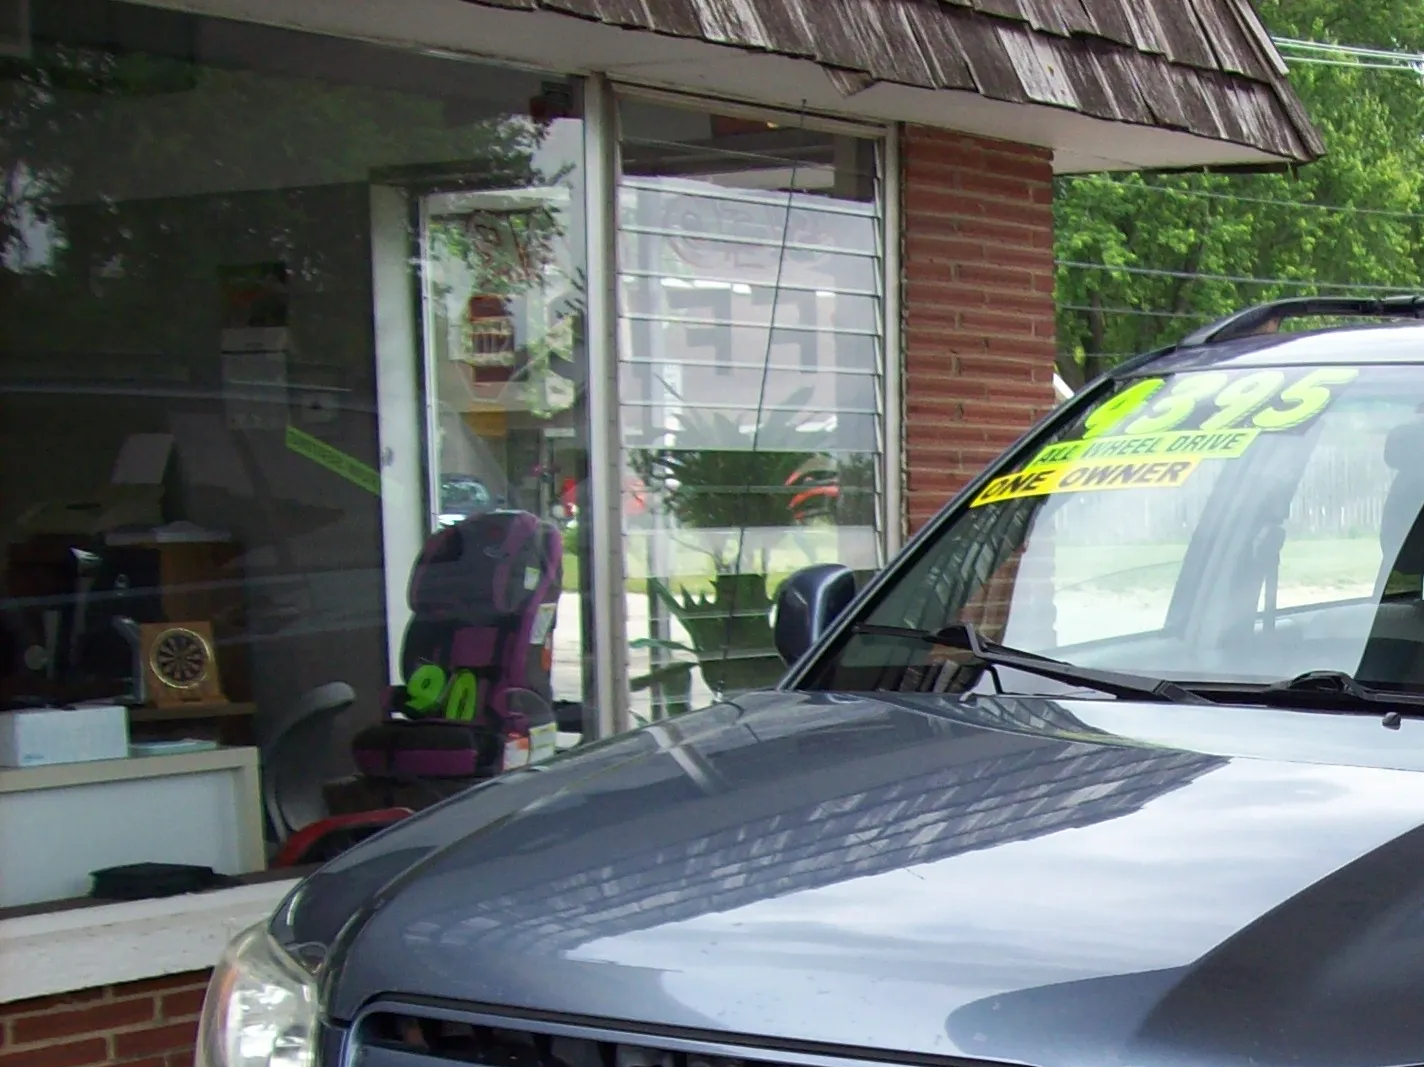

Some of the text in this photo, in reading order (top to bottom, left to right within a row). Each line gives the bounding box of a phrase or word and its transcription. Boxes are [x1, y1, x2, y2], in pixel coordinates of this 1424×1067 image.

[1039, 432, 1248, 462] ALL WHEEL DRIVE
[980, 461, 1192, 500] ONE OWNER
